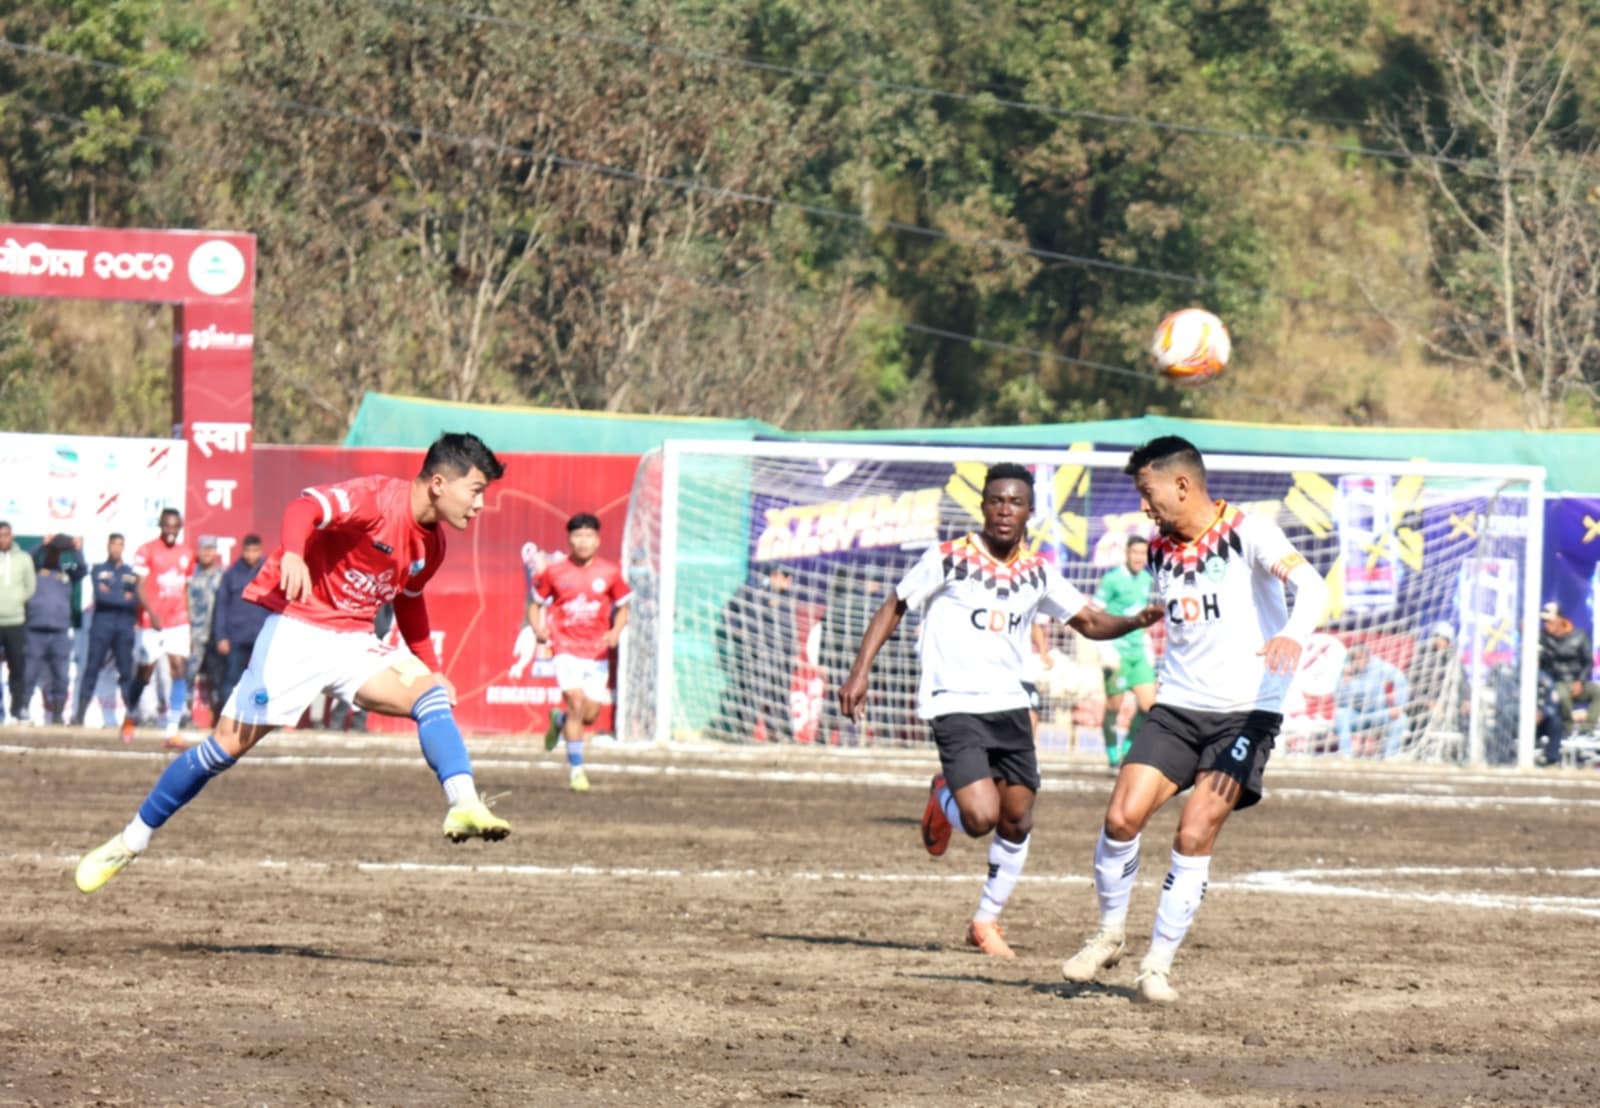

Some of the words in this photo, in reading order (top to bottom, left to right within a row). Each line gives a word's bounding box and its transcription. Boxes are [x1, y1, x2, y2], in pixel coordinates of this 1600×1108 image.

[93, 251, 175, 283] २०८२
[970, 607, 1022, 635] CDH
[1167, 592, 1221, 625] CDH
[1230, 735, 1251, 762] 5
